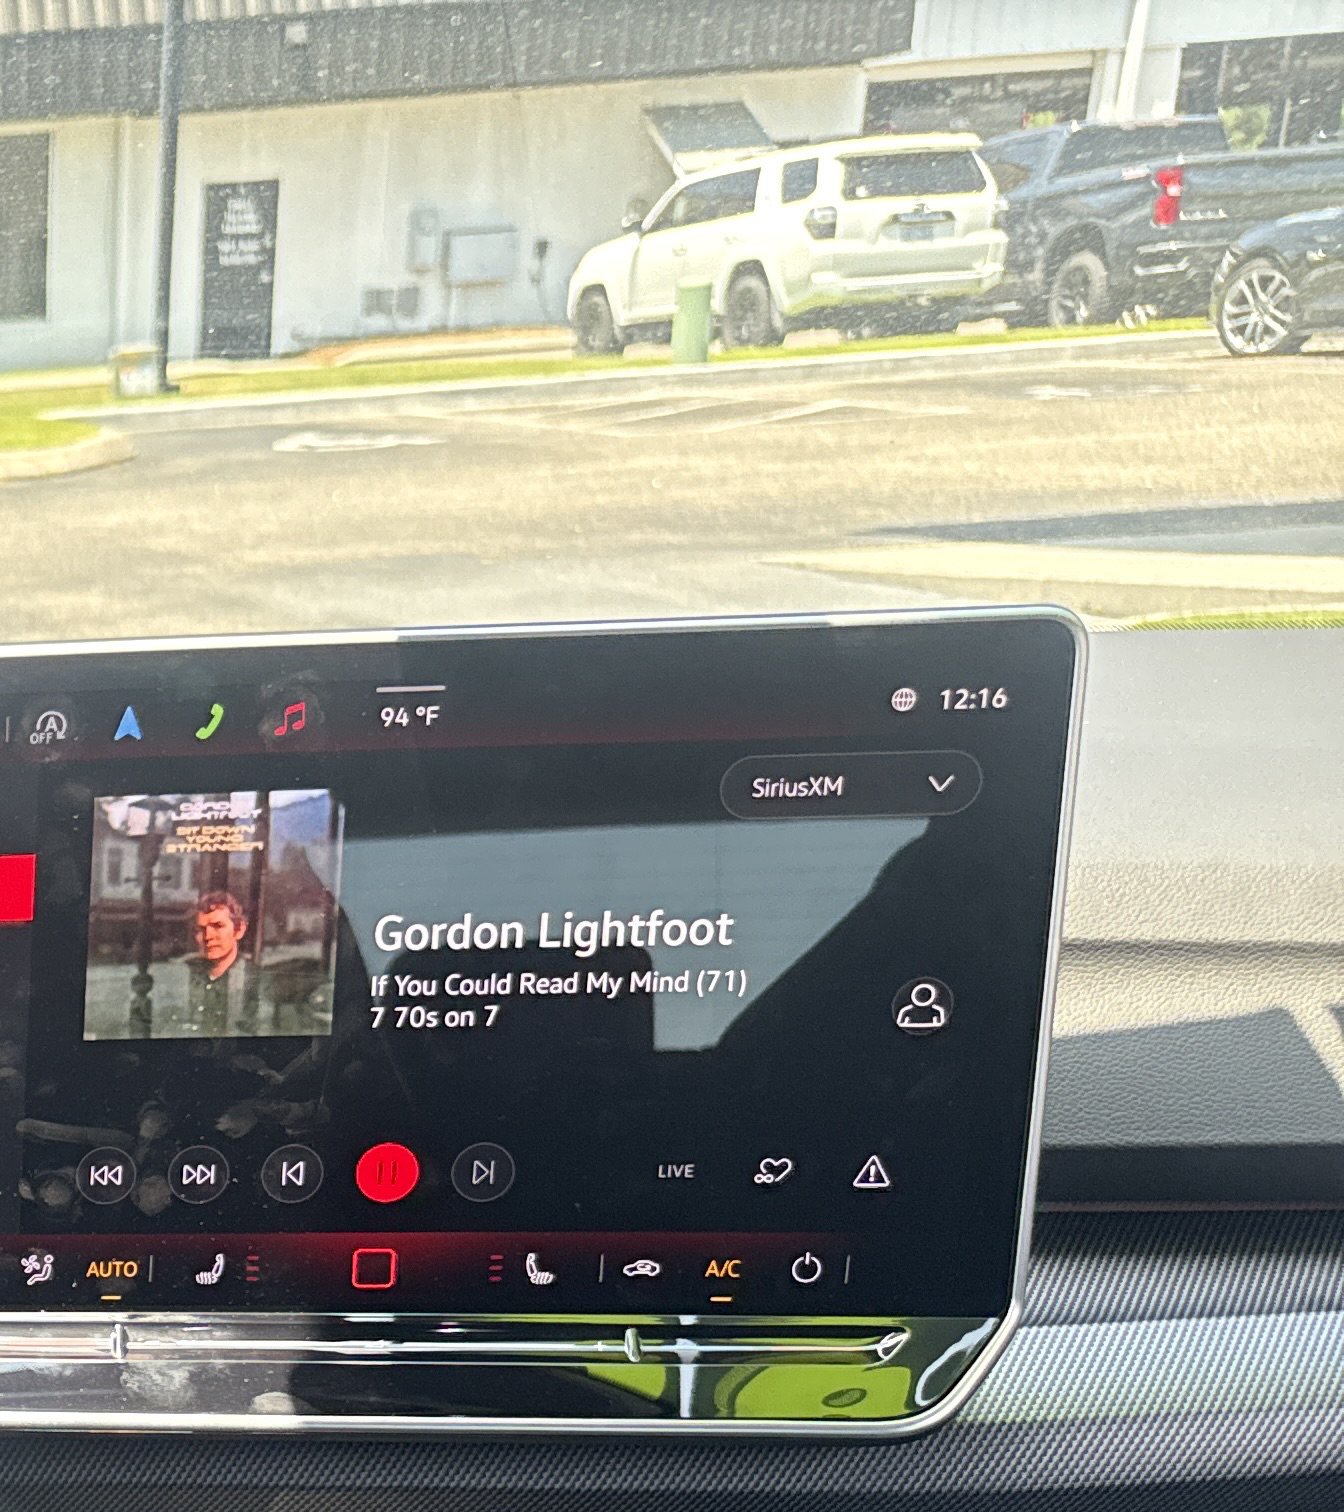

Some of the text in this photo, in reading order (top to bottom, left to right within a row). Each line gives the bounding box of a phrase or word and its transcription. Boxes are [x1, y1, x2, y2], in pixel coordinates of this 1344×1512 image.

[940, 687, 1007, 711] 12:16
[380, 705, 440, 728] 94 °F
[30, 732, 53, 745] OFF
[752, 775, 844, 800] SiriusXM
[374, 909, 734, 957] Gordon Lightfoot
[370, 969, 747, 999] If You Could Read My Mind (71)
[369, 1005, 500, 1028] 7 70s on 7
[657, 1163, 694, 1180] LIVE
[86, 1261, 138, 1279] AUTO
[705, 1258, 742, 1280] A/C
